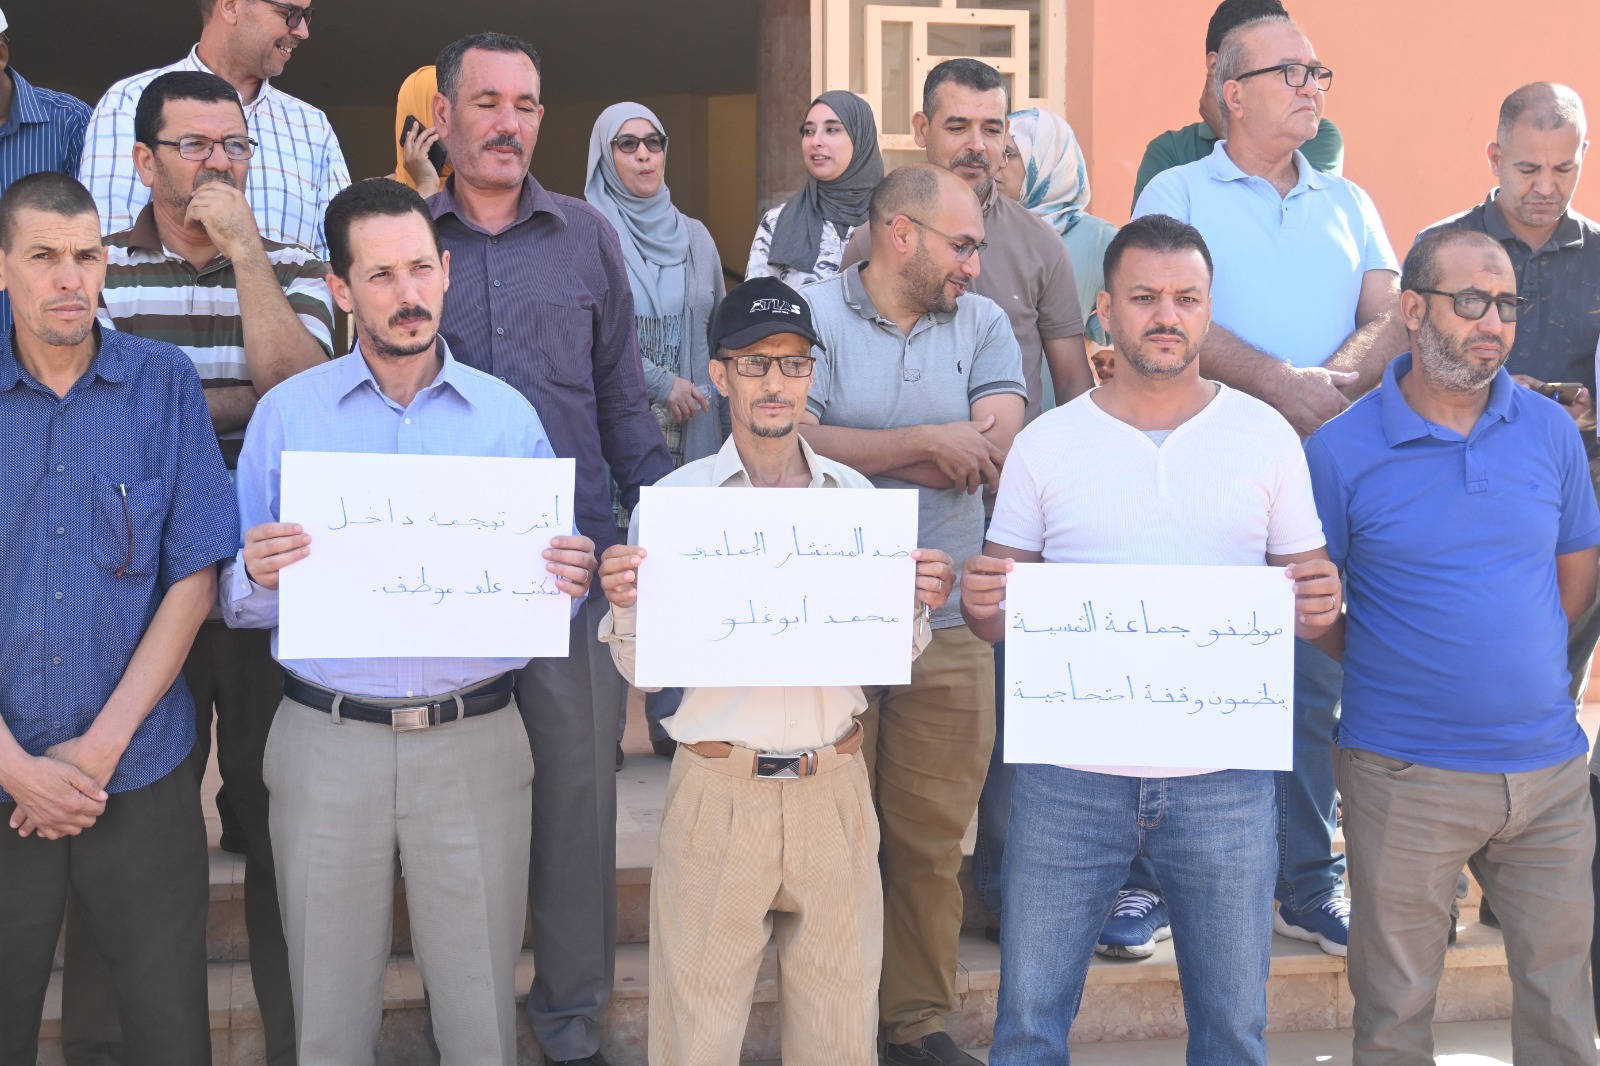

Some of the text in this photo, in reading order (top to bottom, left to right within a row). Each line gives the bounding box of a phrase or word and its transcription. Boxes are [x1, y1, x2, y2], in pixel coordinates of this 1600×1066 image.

[749, 298, 801, 315] ATLAS
[327, 496, 414, 531] داخل
[678, 525, 910, 569] ضد المستشار الجماعي
[463, 570, 503, 595] على
[823, 612, 899, 624] محمد
[1105, 599, 1191, 638] جماعة
[1194, 610, 1283, 648] موظفو
[1013, 662, 1288, 715] ينظمون وقفة احتجاجية
